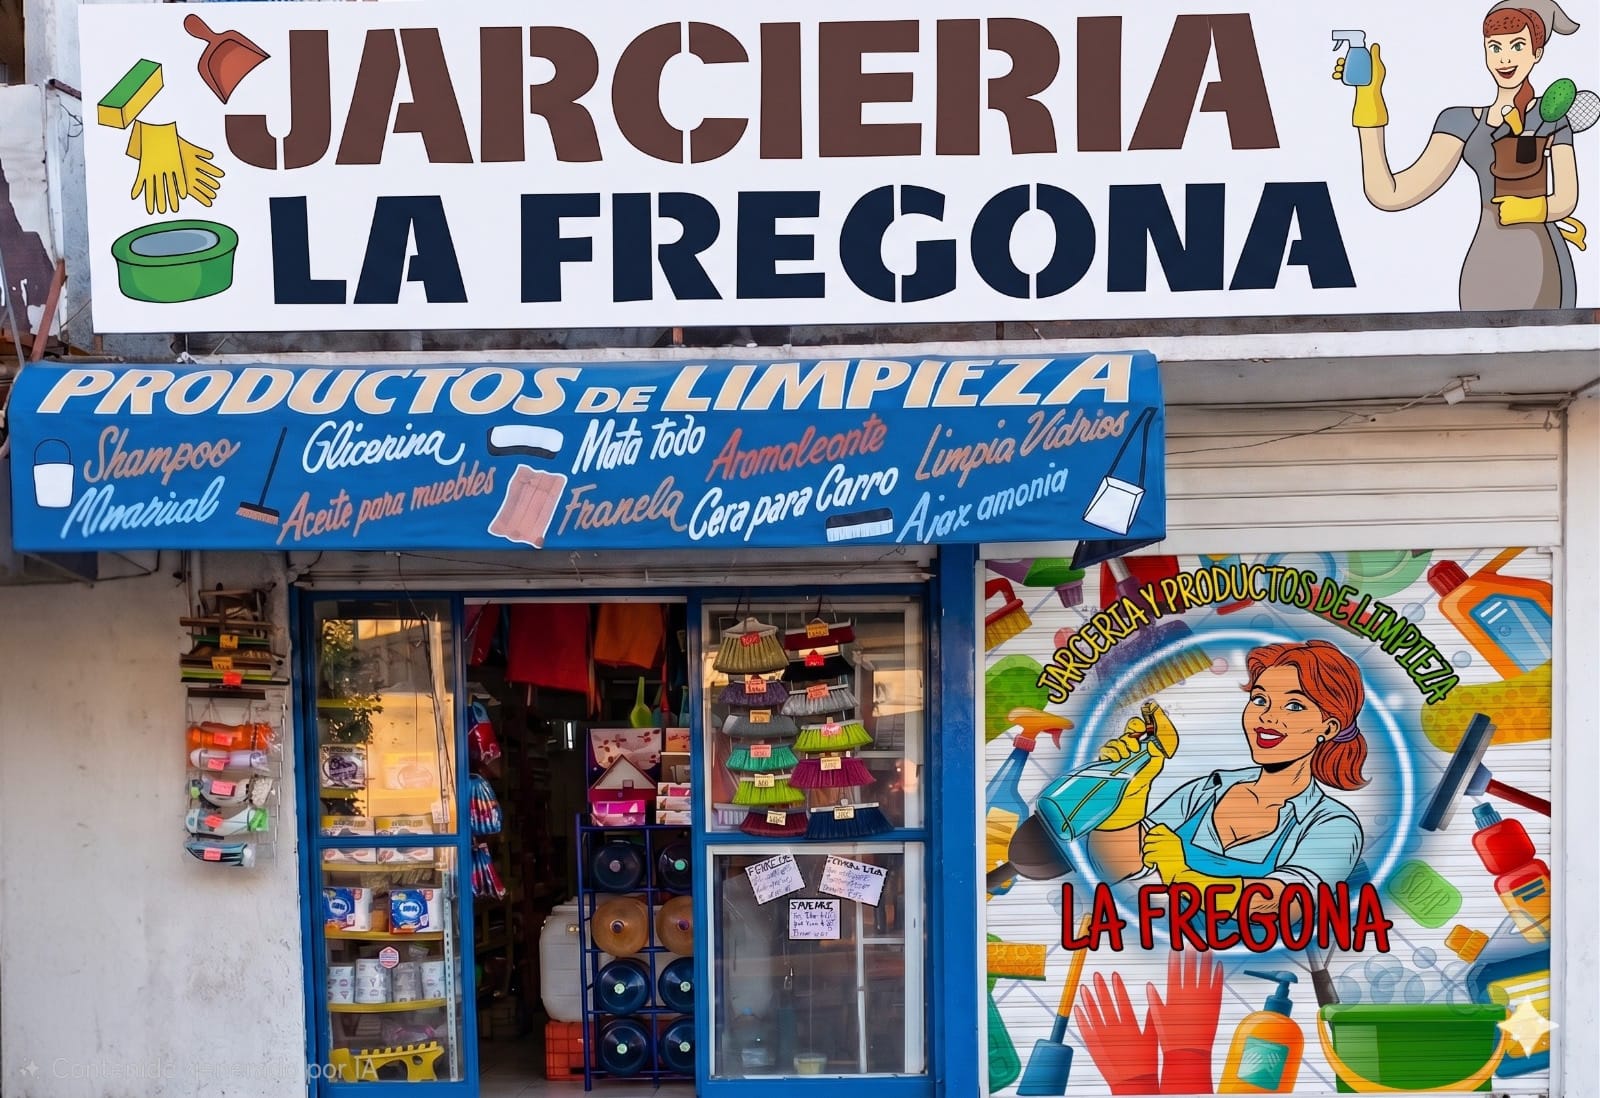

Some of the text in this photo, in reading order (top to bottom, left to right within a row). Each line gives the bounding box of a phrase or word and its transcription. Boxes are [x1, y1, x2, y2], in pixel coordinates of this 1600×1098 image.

[225, 12, 1280, 170] JARCIERIA
[269, 181, 1357, 305] LA FREGONA
[36, 353, 1133, 415] PRODUCTOS DE LIMPIEZA
[84, 425, 241, 486] Shampoo
[302, 420, 466, 474] Glicerina
[571, 418, 643, 475] Mata
[915, 419, 1017, 488] Limpia
[276, 460, 497, 545] Aceite para muebles
[557, 475, 687, 536] Franela
[688, 463, 900, 542] Cera para Carro
[896, 462, 1069, 544] Ajax amonia
[1137, 582, 1164, 619] Y
[1160, 562, 1318, 614] PRODUCTOS
[1313, 576, 1360, 620] DE
[1349, 593, 1460, 706] LIMPIEZA
[1061, 881, 1394, 954] LA FREGONA
[1400, 871, 1450, 916] SOAP
